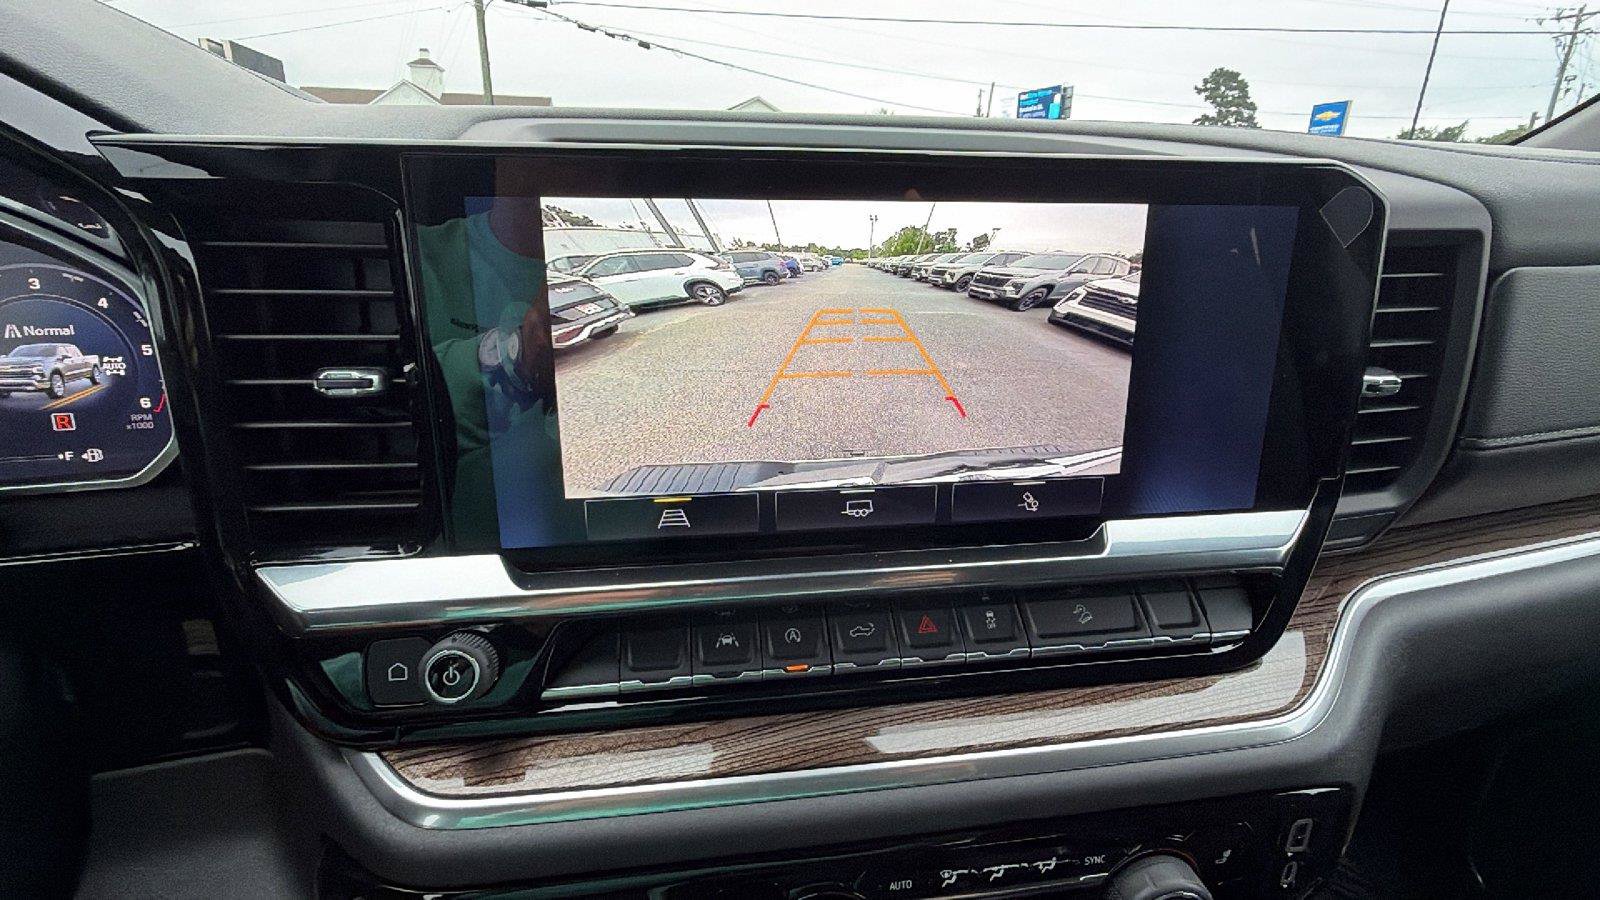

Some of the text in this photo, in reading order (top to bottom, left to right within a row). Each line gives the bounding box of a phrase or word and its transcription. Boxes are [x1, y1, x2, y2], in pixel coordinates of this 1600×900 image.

[28, 278, 40, 289] 3
[97, 298, 108, 309] 4
[23, 325, 75, 336] Normal
[141, 344, 153, 356] 5
[102, 362, 127, 370] AUTO
[140, 397, 152, 409] 6
[56, 415, 72, 430] R
[131, 413, 153, 421] RPM
[64, 451, 74, 461] F
[1084, 854, 1106, 866] SYNC
[889, 879, 913, 891] AUTO
